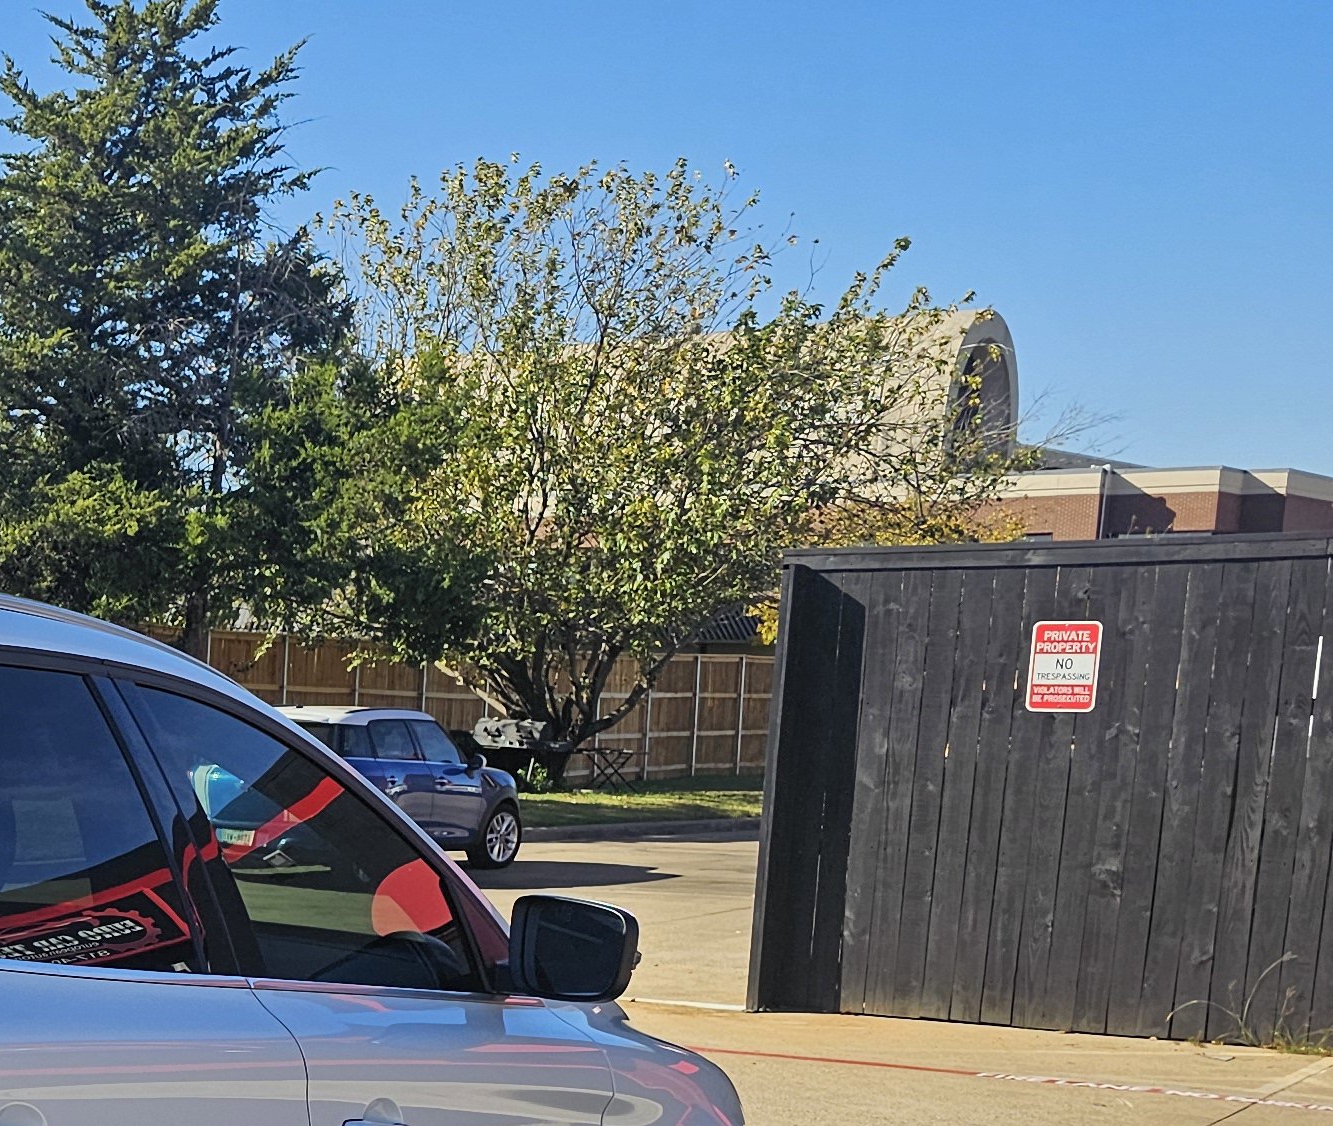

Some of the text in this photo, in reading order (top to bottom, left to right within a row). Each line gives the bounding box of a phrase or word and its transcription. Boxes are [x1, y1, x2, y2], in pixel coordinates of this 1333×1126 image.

[1044, 630, 1091, 641] PRIVATE
[1036, 642, 1096, 653] PROPERTY
[1055, 658, 1073, 670] NO
[1037, 672, 1090, 681] TRESPASSING
[1033, 686, 1090, 695] VIOLATORS WILL
[1032, 694, 1090, 703] BE PROSECUTED
